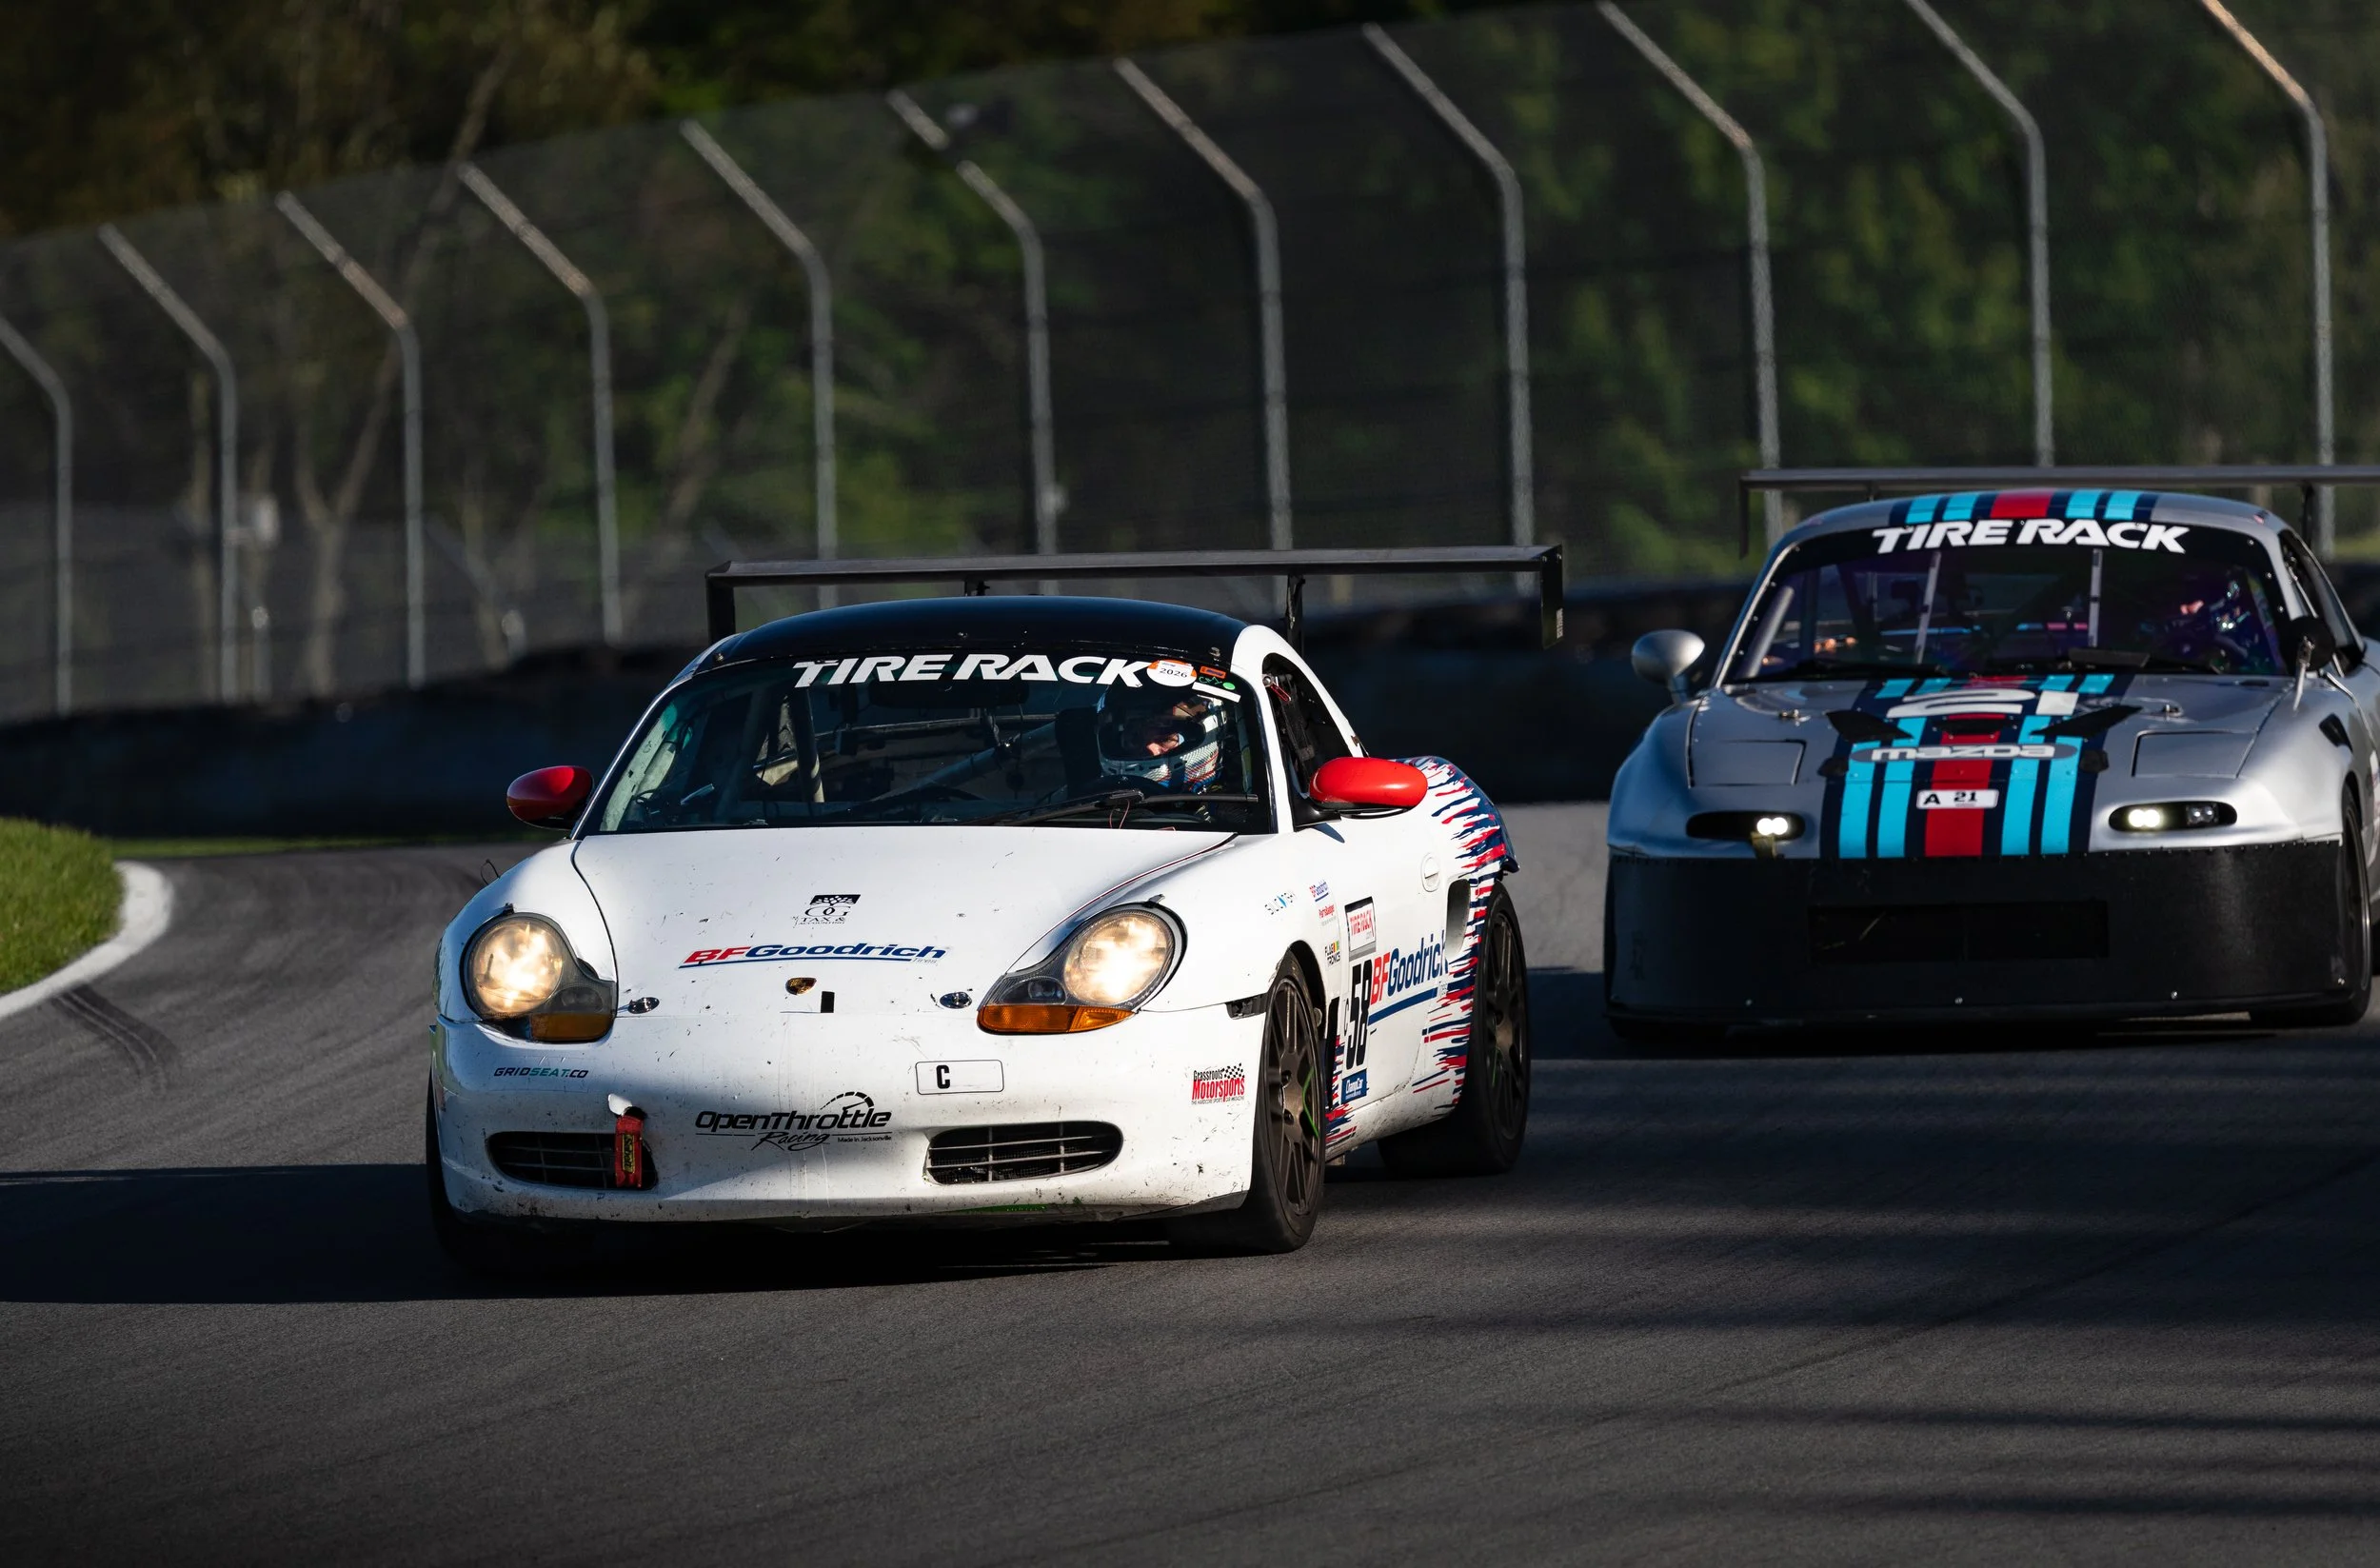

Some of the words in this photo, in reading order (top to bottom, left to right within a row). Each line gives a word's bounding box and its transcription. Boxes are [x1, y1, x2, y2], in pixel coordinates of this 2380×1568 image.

[1872, 519, 2013, 554] TIRE
[2016, 518, 2190, 554] RACK
[792, 653, 954, 688] TIRE
[952, 653, 1151, 688] RACK
[1159, 667, 1188, 679] 2026
[1923, 793, 1941, 805] A
[1954, 791, 1977, 803] 21
[683, 943, 946, 963] BFGoodrich
[1371, 929, 1448, 1005] BFGoodrich
[1346, 959, 1373, 1070] 58
[493, 1066, 589, 1079] GRIDSEAT.CO
[936, 1064, 951, 1089] C
[1193, 1069, 1223, 1082] Grassroots
[1191, 1077, 1245, 1102] Motorsports
[695, 1106, 893, 1133] OpenThrottle
[750, 1130, 831, 1152] Racing
